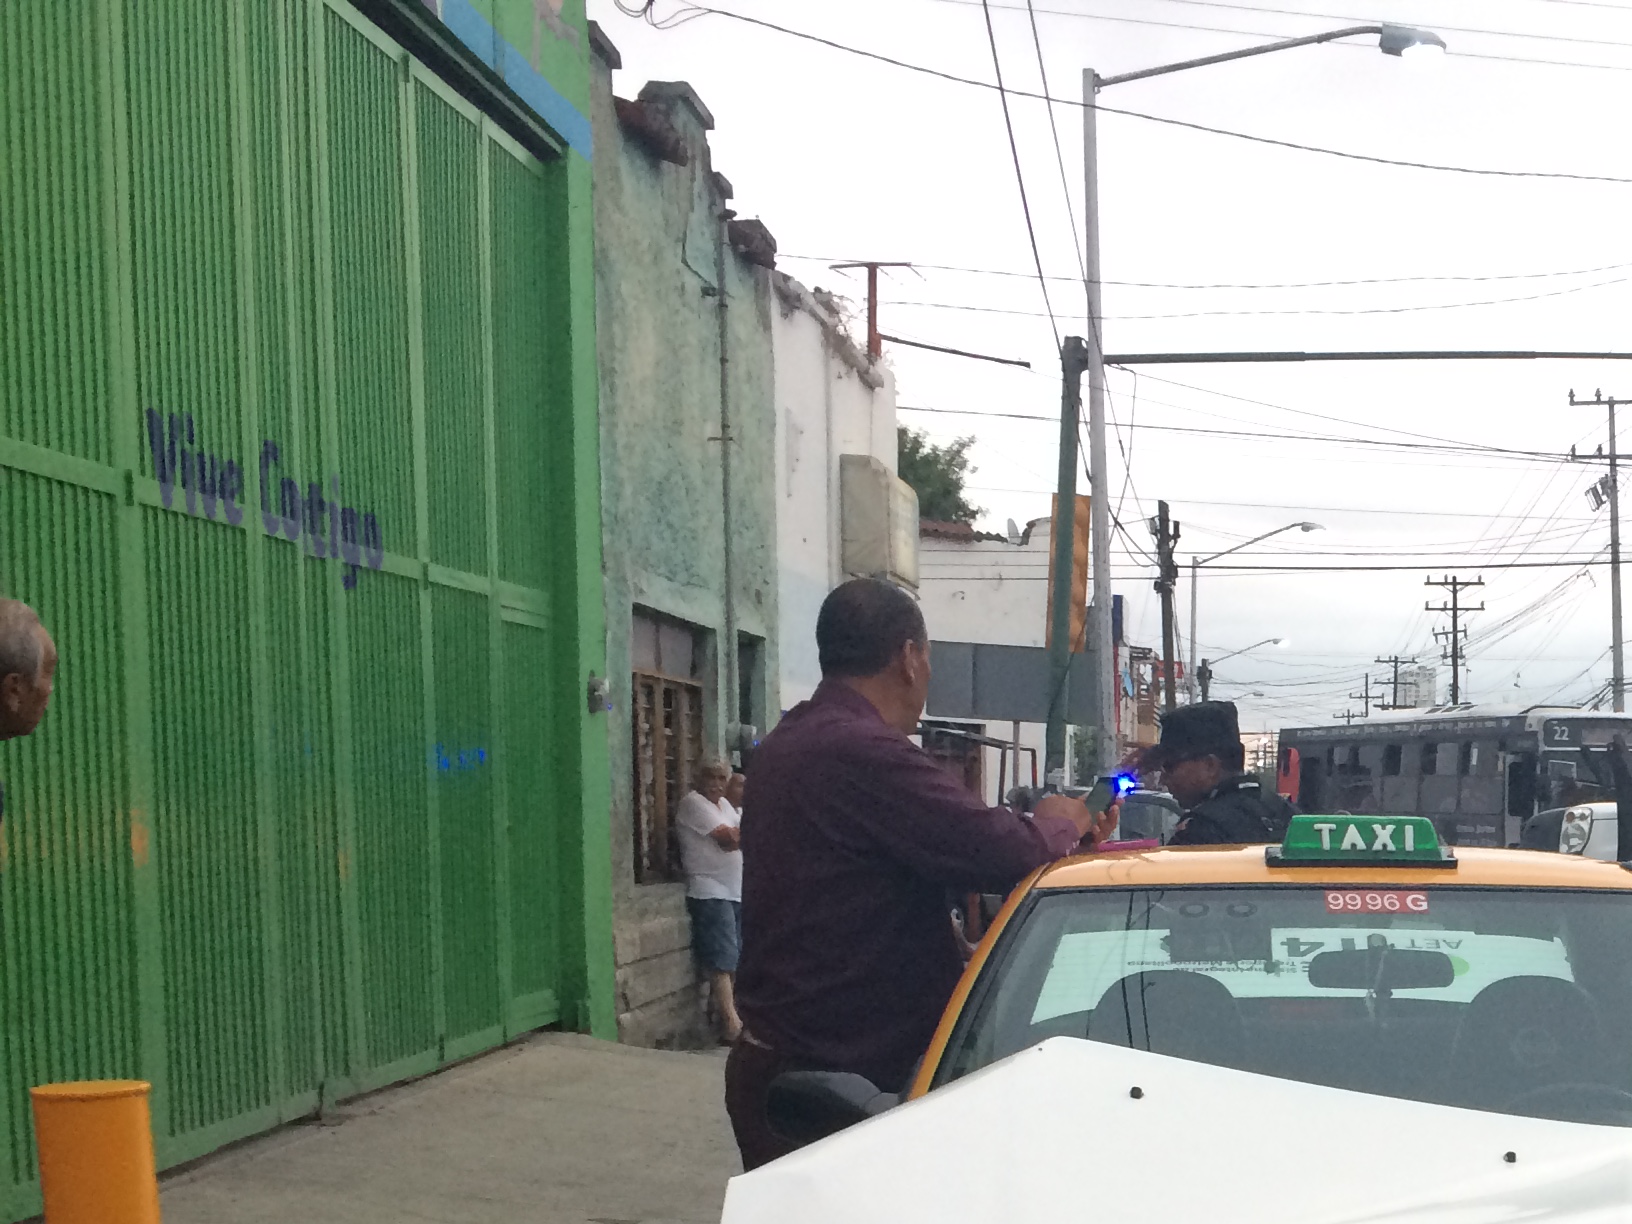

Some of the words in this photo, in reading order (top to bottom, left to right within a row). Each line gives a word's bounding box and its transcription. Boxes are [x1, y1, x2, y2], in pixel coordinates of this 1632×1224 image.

[146, 407, 244, 526] Vive
[1553, 726, 1570, 741] 22
[1313, 823, 1415, 851] TAXI
